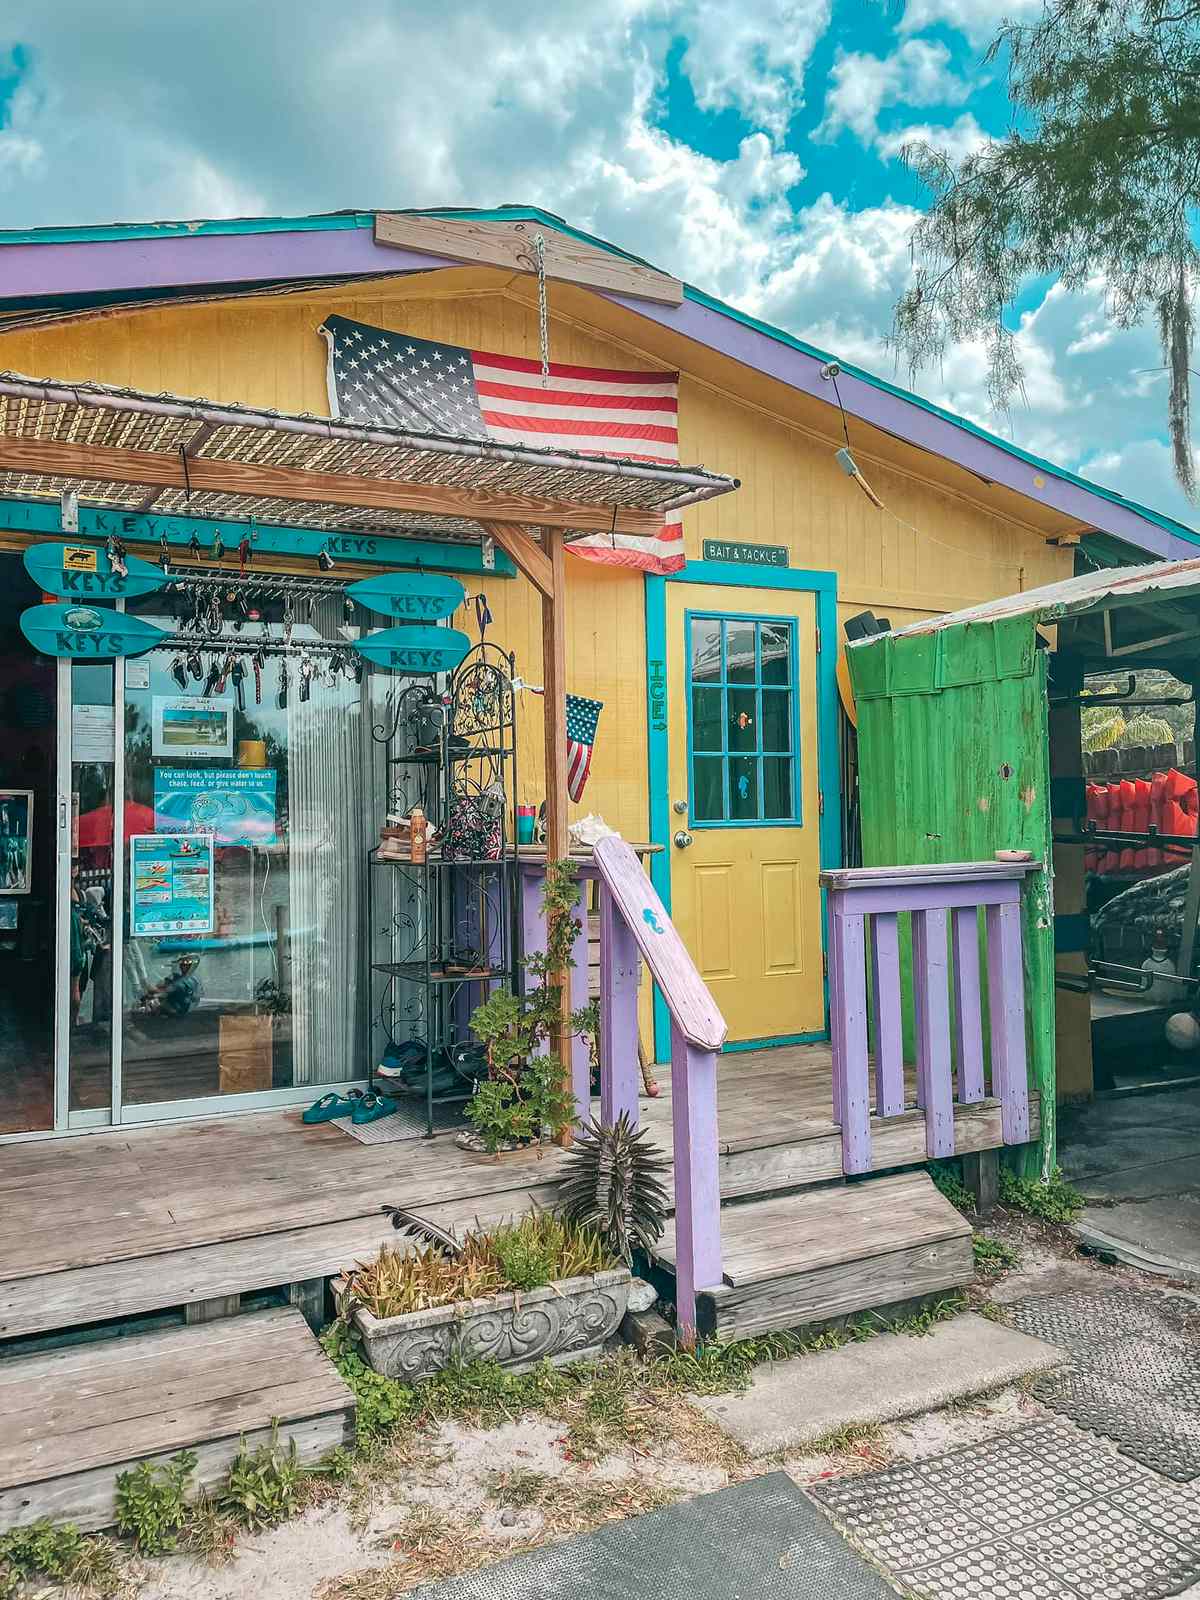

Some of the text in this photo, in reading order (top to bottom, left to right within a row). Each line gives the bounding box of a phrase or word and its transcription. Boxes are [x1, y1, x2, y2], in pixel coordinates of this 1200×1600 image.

[95, 514, 182, 537] KEYS
[328, 537, 377, 554] KEYS
[709, 545, 730, 559] BAIT
[733, 548, 739, 559] &
[742, 548, 777, 563] TACKLE
[61, 571, 126, 592] KEYS
[390, 597, 446, 614] KEYS
[56, 631, 124, 653] KEYS
[390, 650, 444, 667] KEYS
[649, 660, 665, 719] ICE
[160, 771, 172, 779] You
[204, 771, 215, 779] but
[216, 771, 237, 781] please
